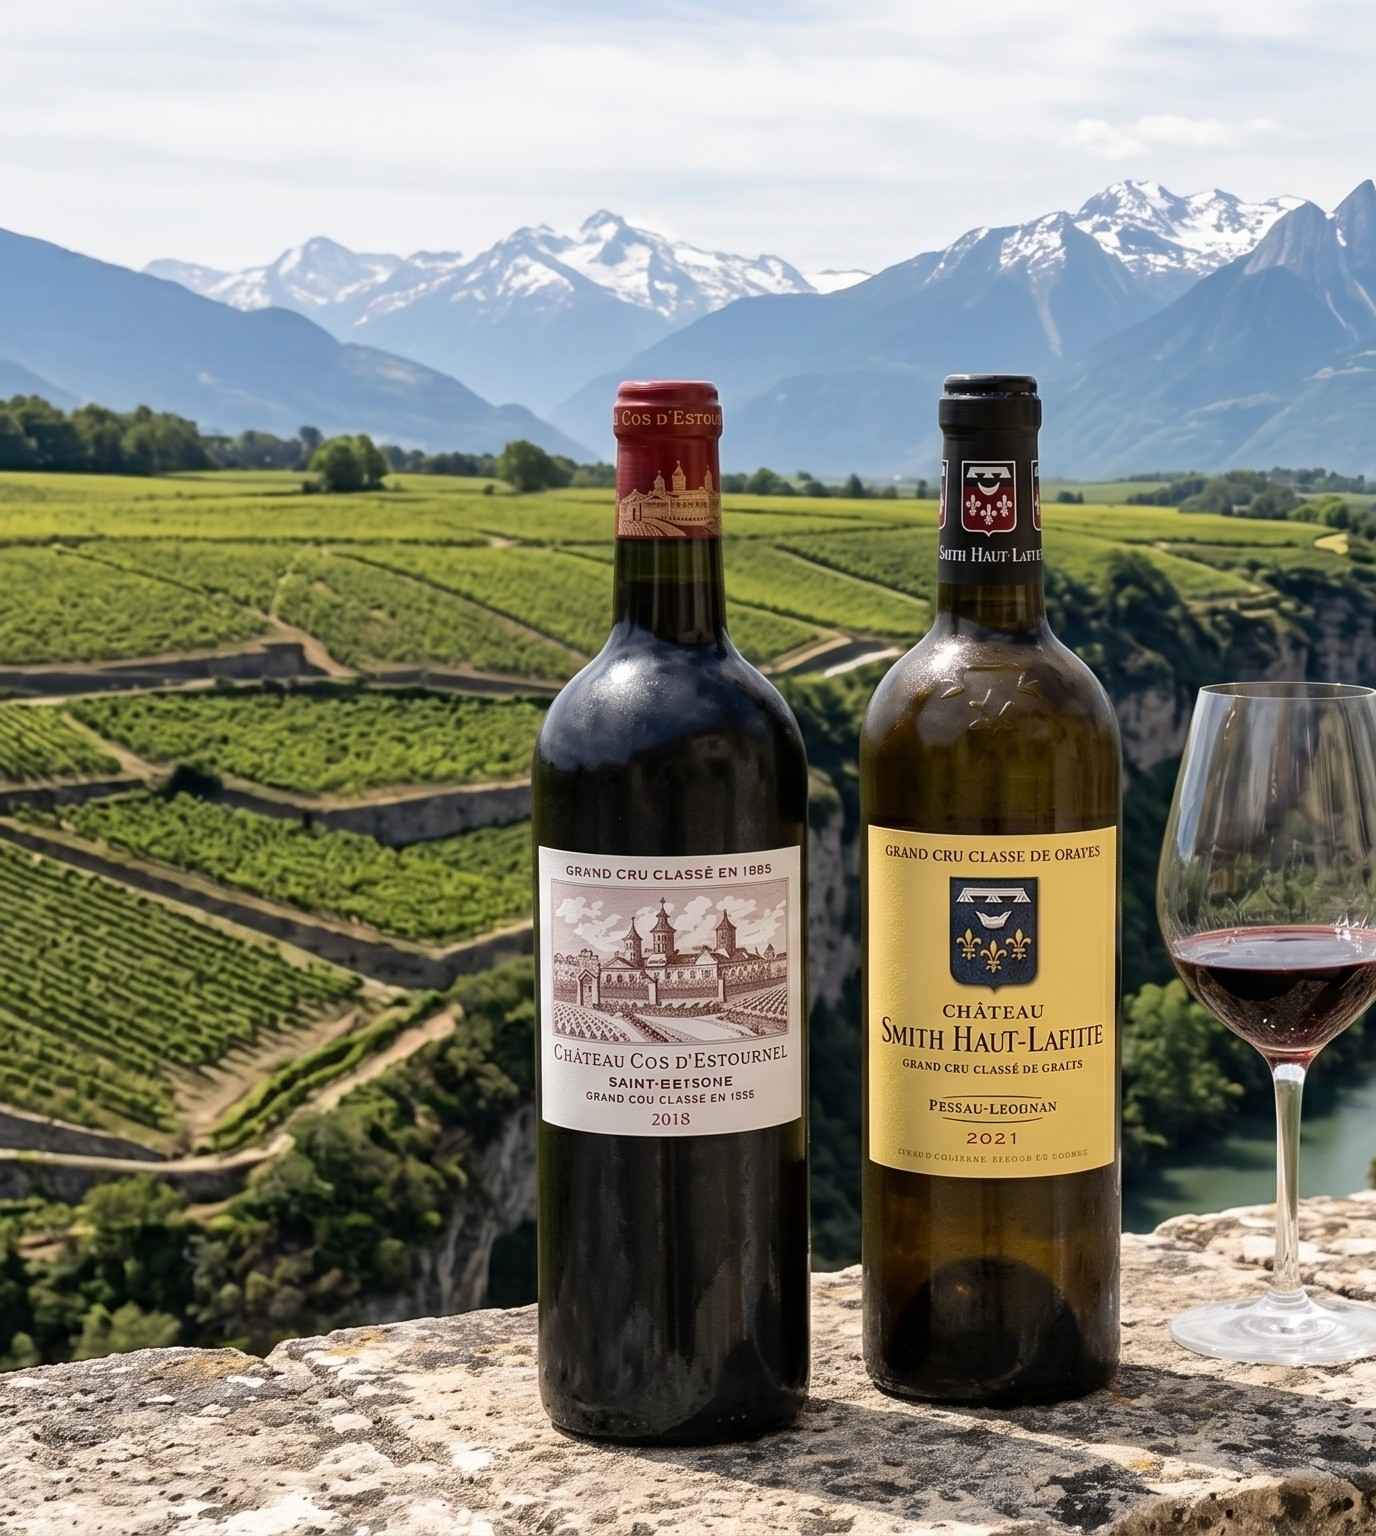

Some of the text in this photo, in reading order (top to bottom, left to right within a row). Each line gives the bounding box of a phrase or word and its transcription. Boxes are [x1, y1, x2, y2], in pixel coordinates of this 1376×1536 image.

[622, 410, 651, 426] COS
[885, 845, 928, 860] GRAND
[933, 849, 963, 862] CRU
[968, 850, 1025, 863] CLASSE
[1030, 850, 1051, 862] DE
[566, 865, 612, 879] GRAND
[616, 869, 648, 880] CRU
[719, 867, 737, 878] EN
[942, 1001, 1044, 1019] CHÂTEAU
[882, 1016, 944, 1050] SMITH
[630, 1053, 669, 1069] COS
[676, 1045, 788, 1069] D'ESTOURNEL
[902, 1058, 941, 1072] GRAND
[944, 1063, 969, 1074] CRU
[1023, 1064, 1039, 1074] DE
[586, 1092, 625, 1103] GRAND
[629, 1095, 654, 1104] COU
[659, 1094, 706, 1104] CLASSE
[710, 1093, 726, 1103] EN
[651, 1112, 690, 1126] 2018
[966, 1132, 1017, 1145] 2021
